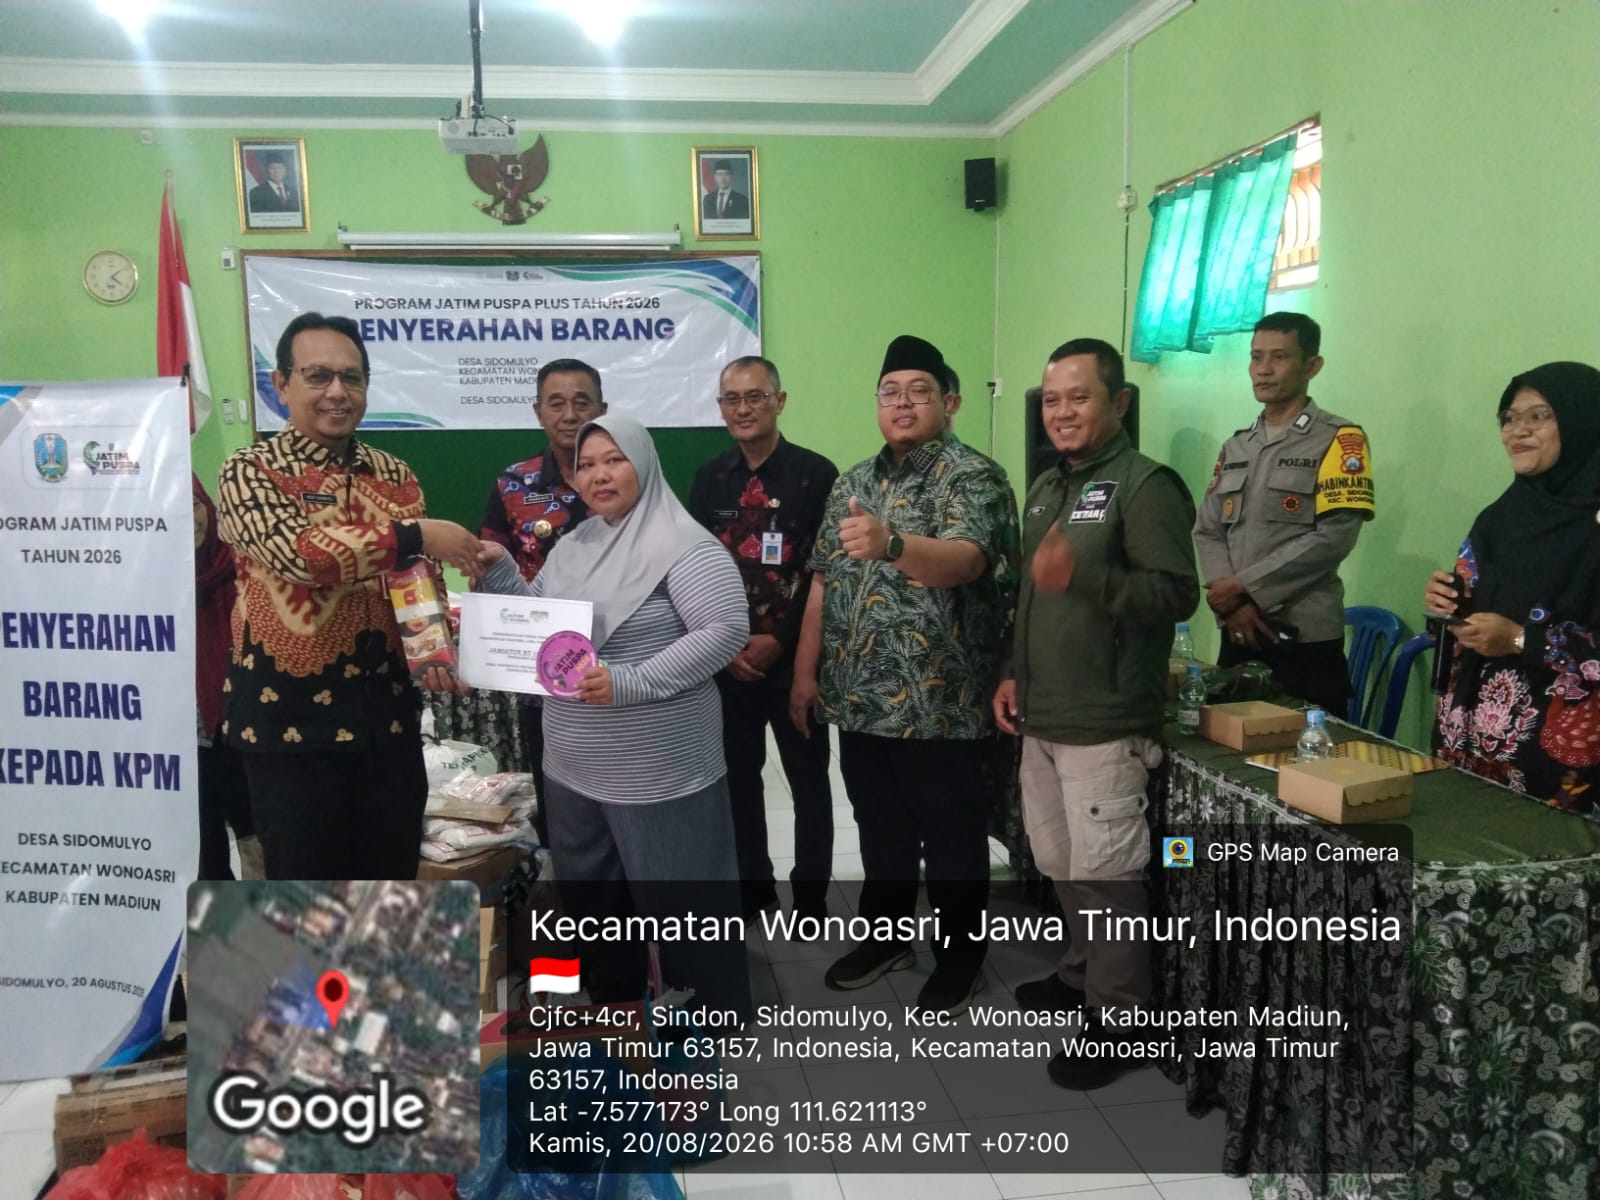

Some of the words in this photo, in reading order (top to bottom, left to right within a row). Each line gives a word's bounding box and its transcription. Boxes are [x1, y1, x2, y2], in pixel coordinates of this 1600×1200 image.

[354, 298, 432, 310] PROGRAM
[434, 298, 481, 310] JATIM
[483, 298, 532, 310] PUSPA
[534, 298, 570, 310] PLUS
[572, 297, 623, 310] TAHUN
[626, 297, 661, 309] 2026
[359, 318, 544, 342] ENYERAHAN
[551, 317, 676, 342] BARANG
[458, 357, 482, 366] DESA
[484, 357, 539, 367] SIDOMULYO
[459, 367, 516, 376] KECAMATAN
[518, 367, 541, 376] WON
[459, 376, 512, 385] KABUPATEN
[514, 376, 538, 385] MAD
[460, 396, 485, 405] DESA
[95, 452, 130, 461] JATIM
[1277, 457, 1318, 469] POLRI
[0, 516, 57, 531] GRAM
[60, 516, 111, 532] JATIM
[115, 517, 168, 532] PUSPA
[21, 549, 81, 564] TAHUN
[84, 549, 122, 564] 2026
[0, 612, 176, 652] ENYERAHAN
[553, 649, 575, 673] JATIM
[562, 648, 588, 675] PUSPA
[23, 681, 142, 721] BARANG
[113, 751, 181, 792] KPM
[18, 832, 59, 847] DESA
[63, 833, 152, 851] SIDOMULYO
[0, 860, 92, 876] ECAMATAN
[96, 863, 176, 884] WONOASRI
[6, 890, 100, 907] KABUPATEN
[104, 893, 161, 912] MADIUN
[0, 975, 69, 989] IDOMULYO,
[72, 976, 87, 987] 20
[90, 978, 132, 995] AGUSTUS
